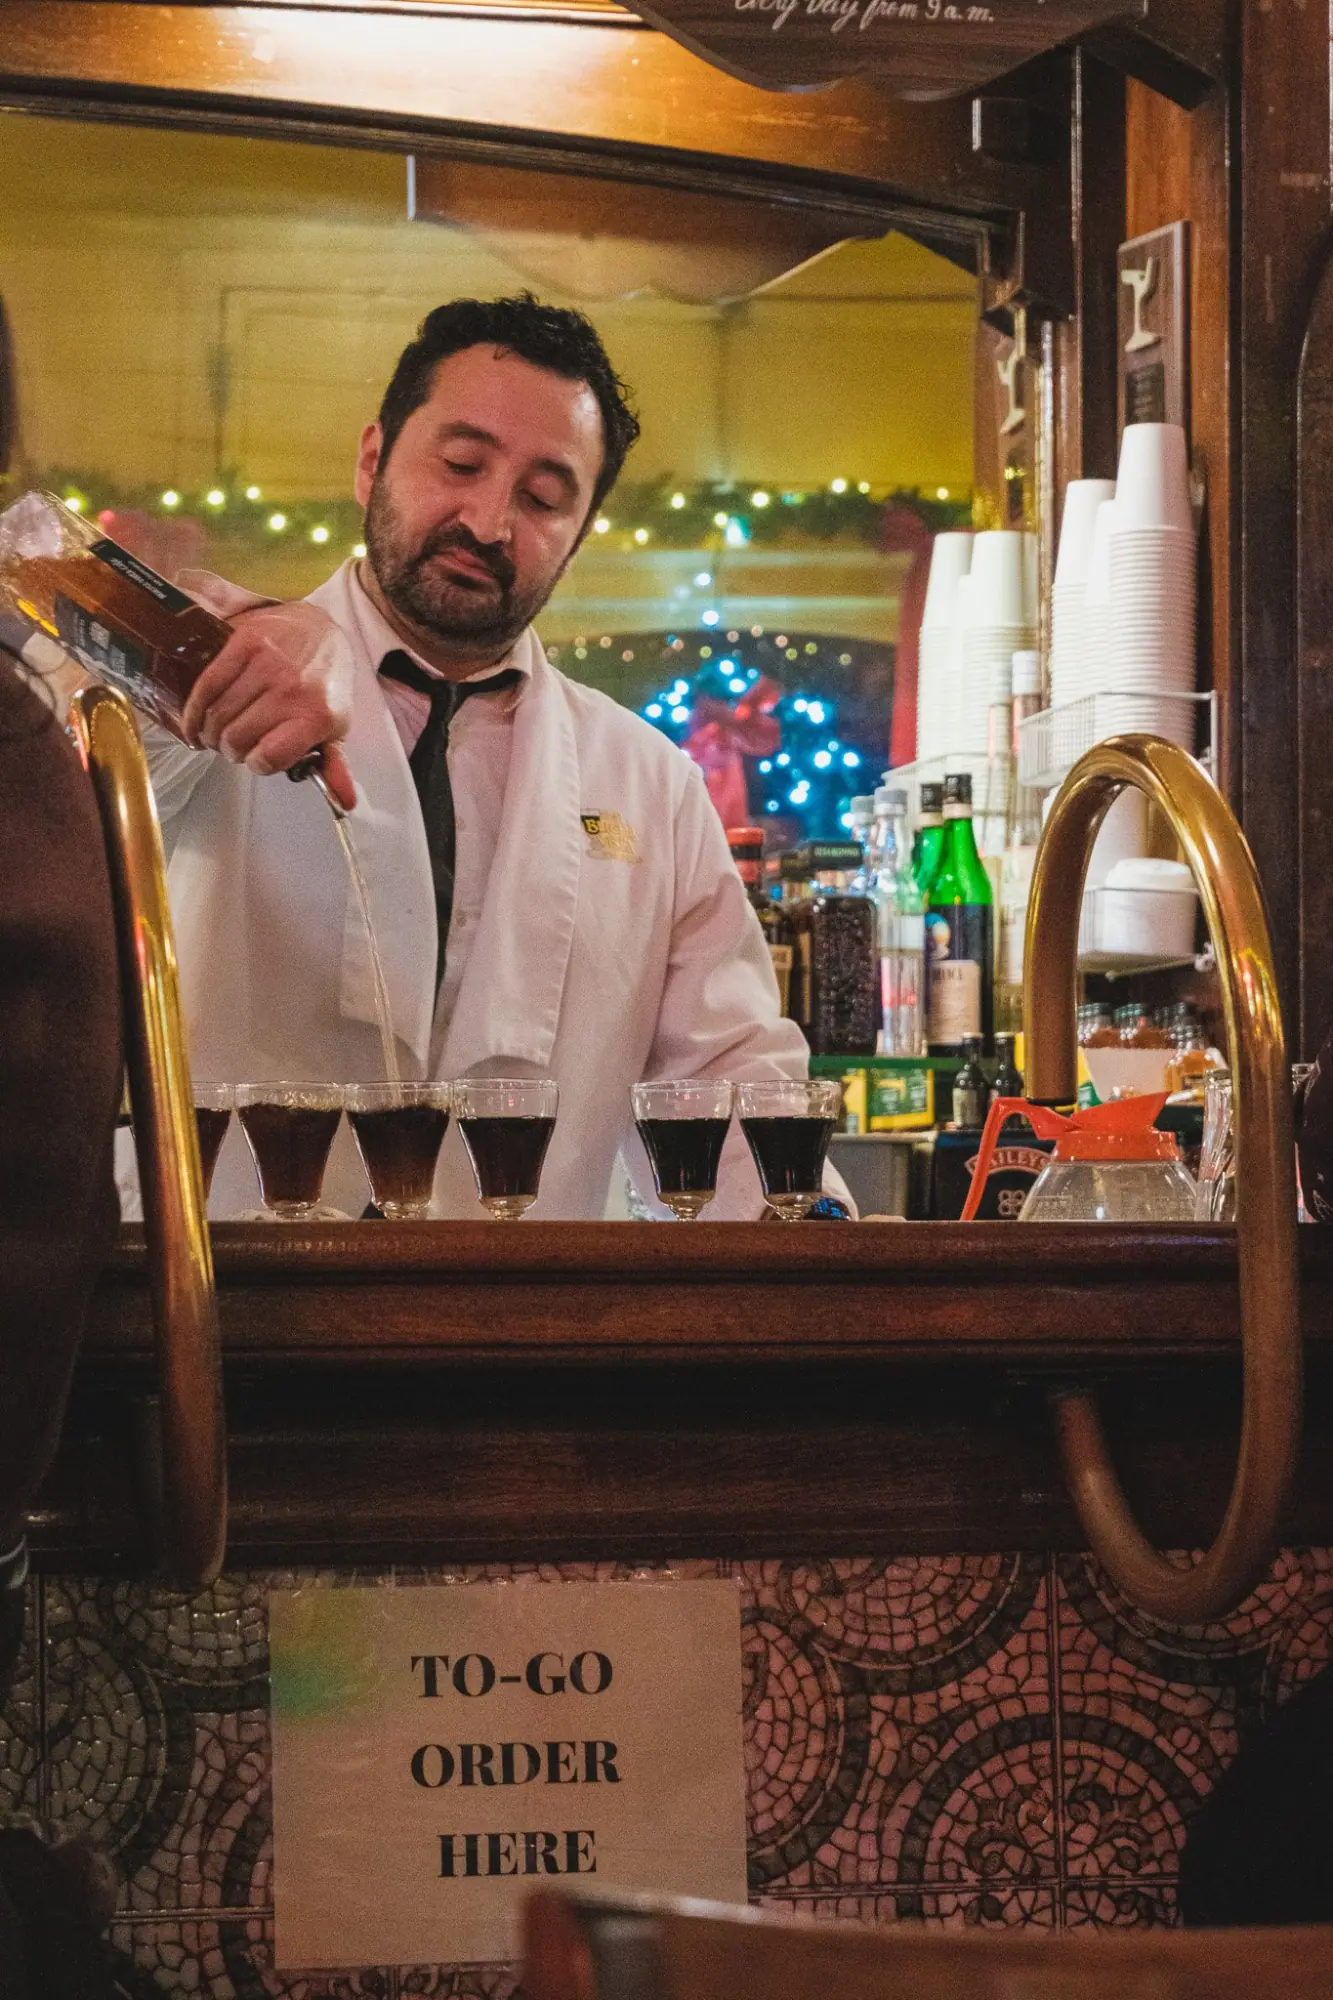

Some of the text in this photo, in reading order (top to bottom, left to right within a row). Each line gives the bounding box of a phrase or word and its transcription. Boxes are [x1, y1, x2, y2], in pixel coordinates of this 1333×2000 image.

[411, 1651, 613, 1698] TO-GO
[411, 1740, 622, 1788] ORDER
[437, 1830, 597, 1878] HERE
